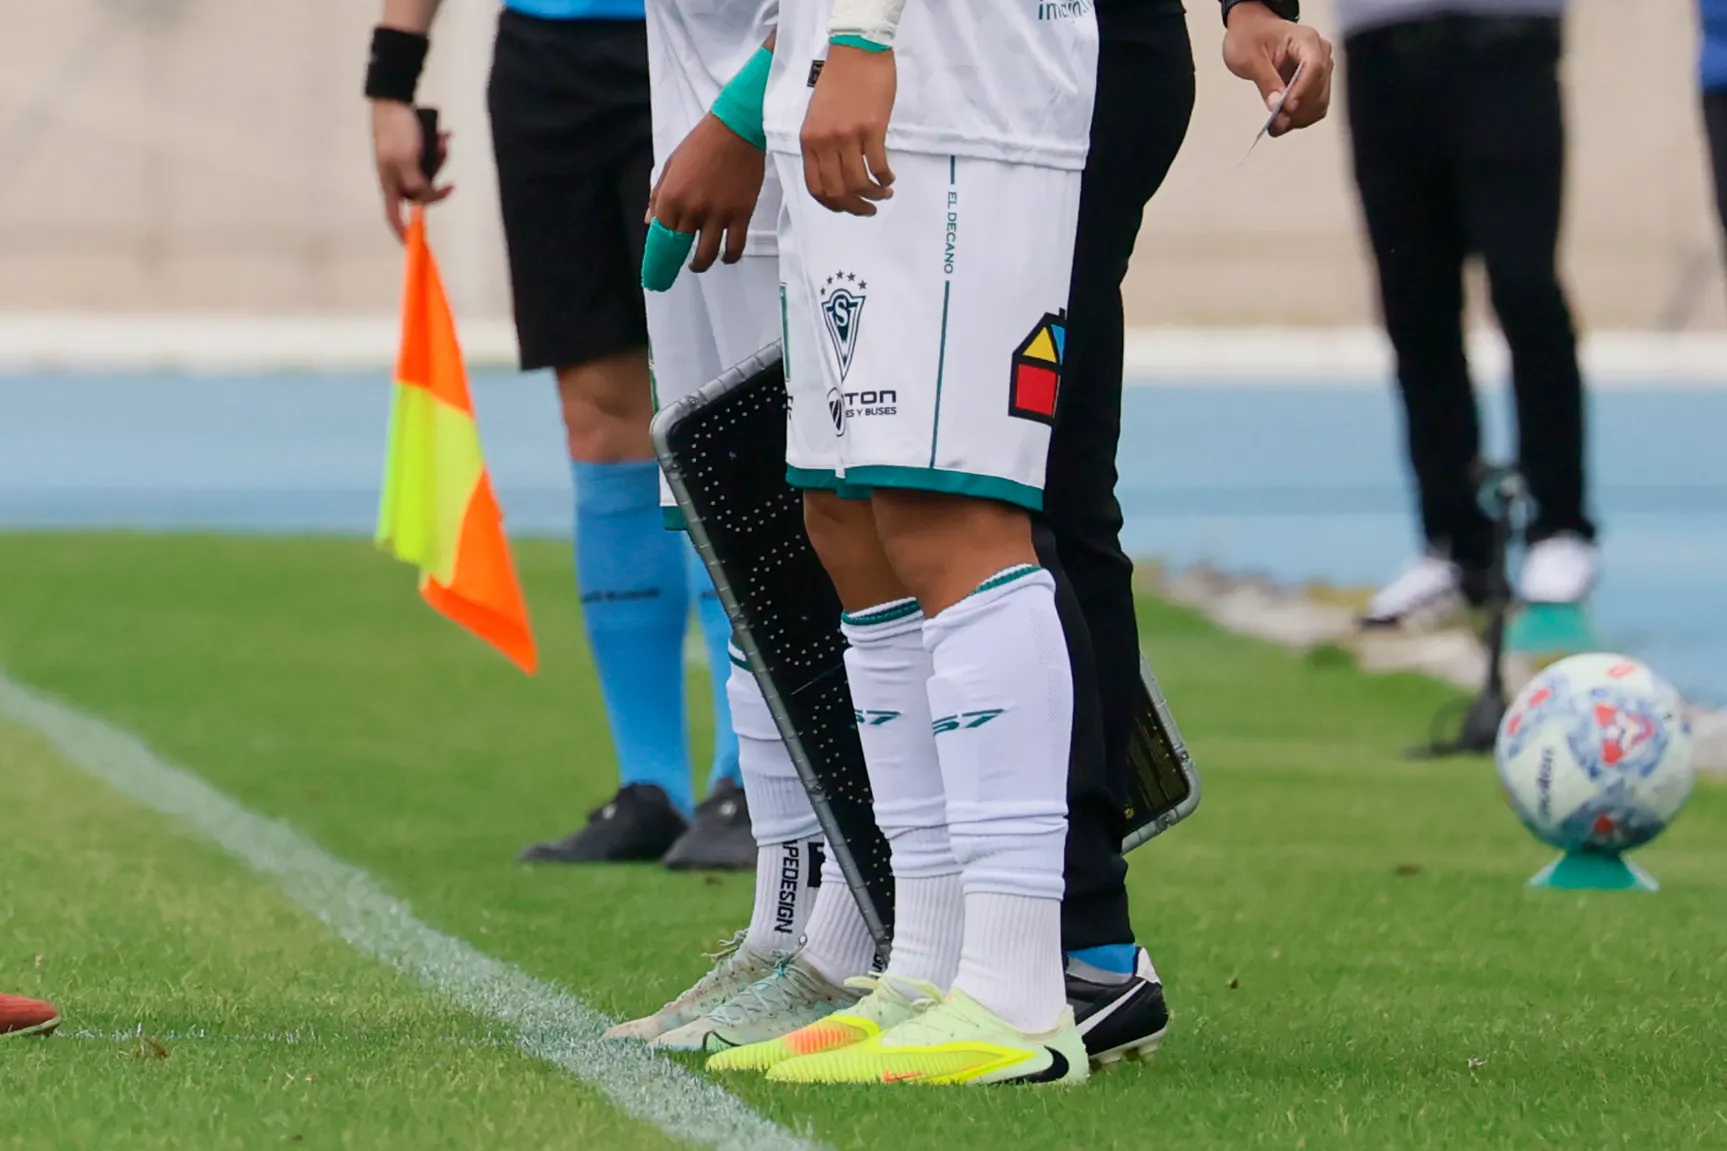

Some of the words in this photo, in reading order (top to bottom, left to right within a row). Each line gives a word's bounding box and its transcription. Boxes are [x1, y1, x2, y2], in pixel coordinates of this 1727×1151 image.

[947, 191, 958, 209] EL
[944, 212, 957, 274] DECANO
[844, 390, 897, 406] TON
[865, 407, 897, 416] BUSES
[932, 708, 1005, 736] S7
